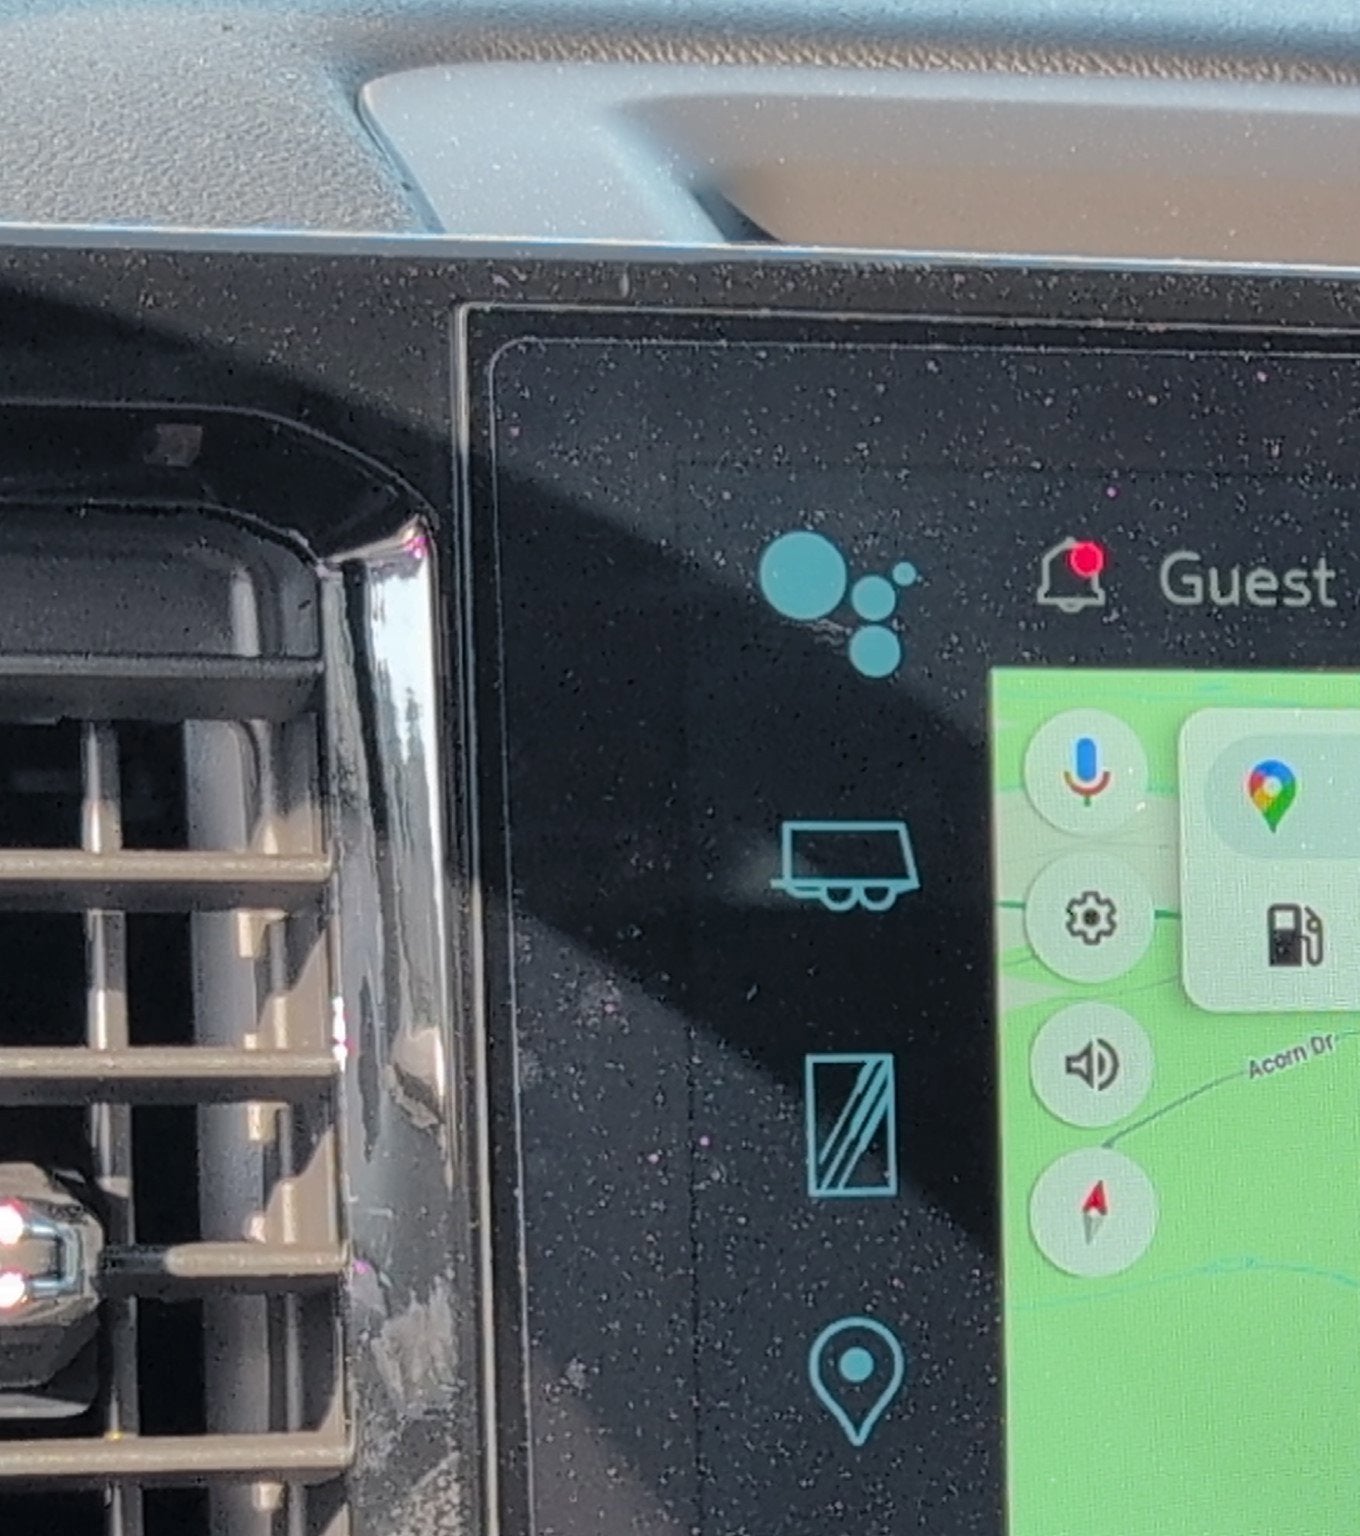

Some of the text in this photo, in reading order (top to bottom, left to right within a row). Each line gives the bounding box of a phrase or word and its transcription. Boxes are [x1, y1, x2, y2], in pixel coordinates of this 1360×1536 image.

[1160, 551, 1337, 608] Guest
[1249, 1033, 1333, 1080] Acorn Dr
